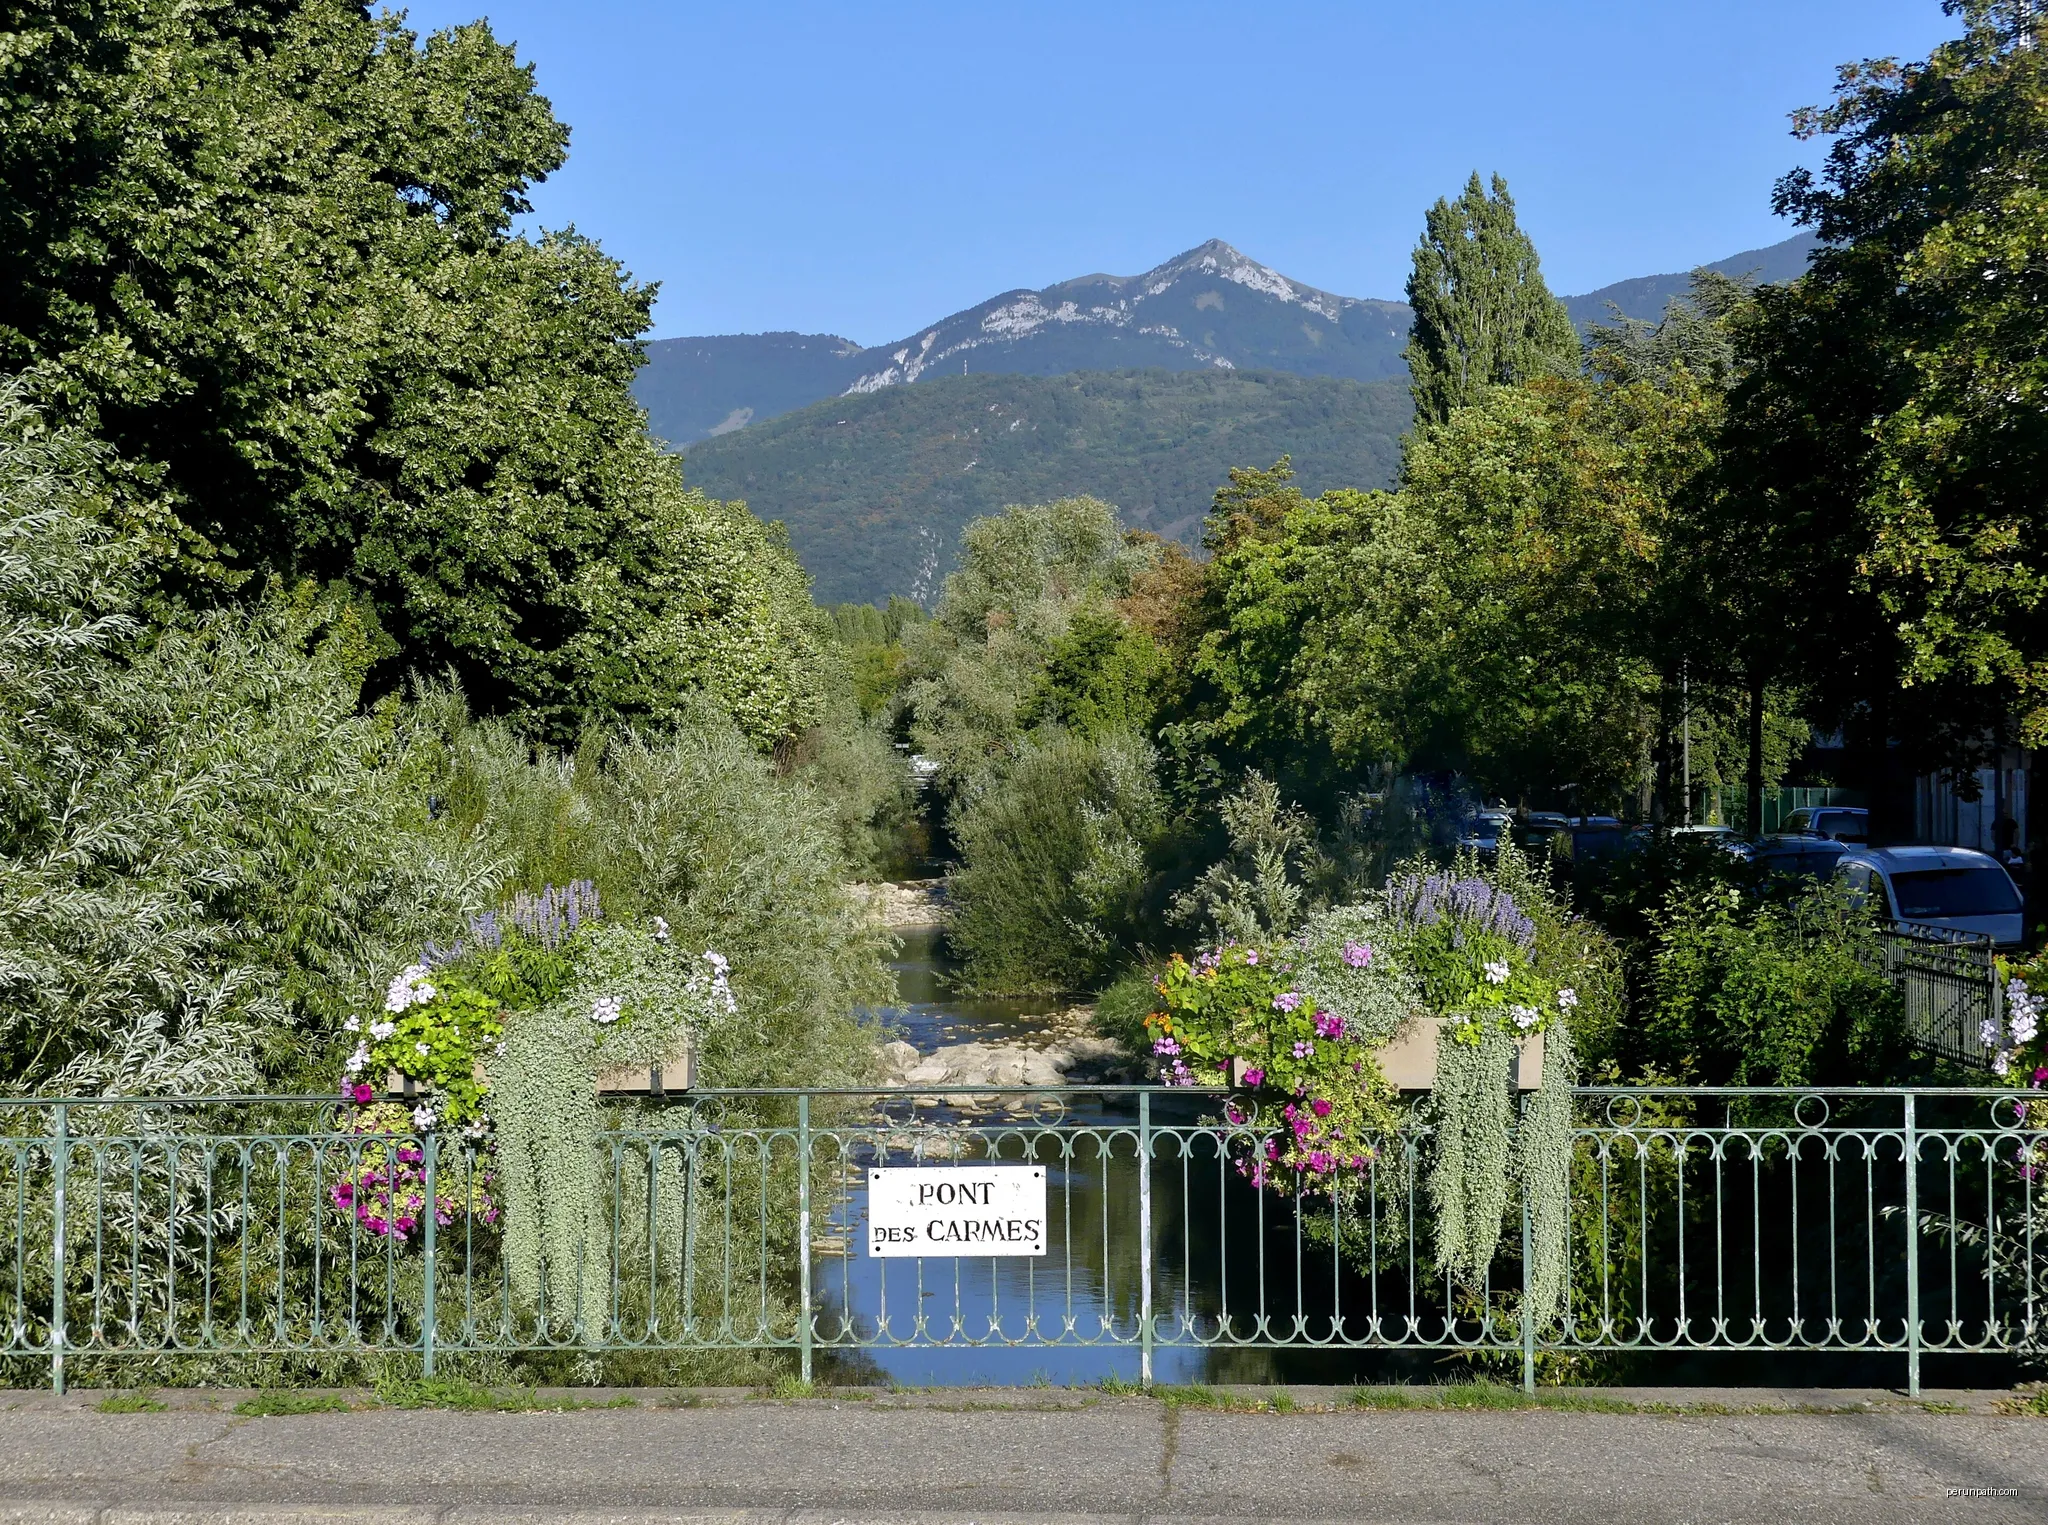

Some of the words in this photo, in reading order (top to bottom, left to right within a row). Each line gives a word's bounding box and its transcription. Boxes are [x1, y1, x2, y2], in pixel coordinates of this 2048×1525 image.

[918, 1182, 996, 1206] PONT
[873, 1227, 916, 1243] DES
[926, 1219, 1040, 1242] CARMES
